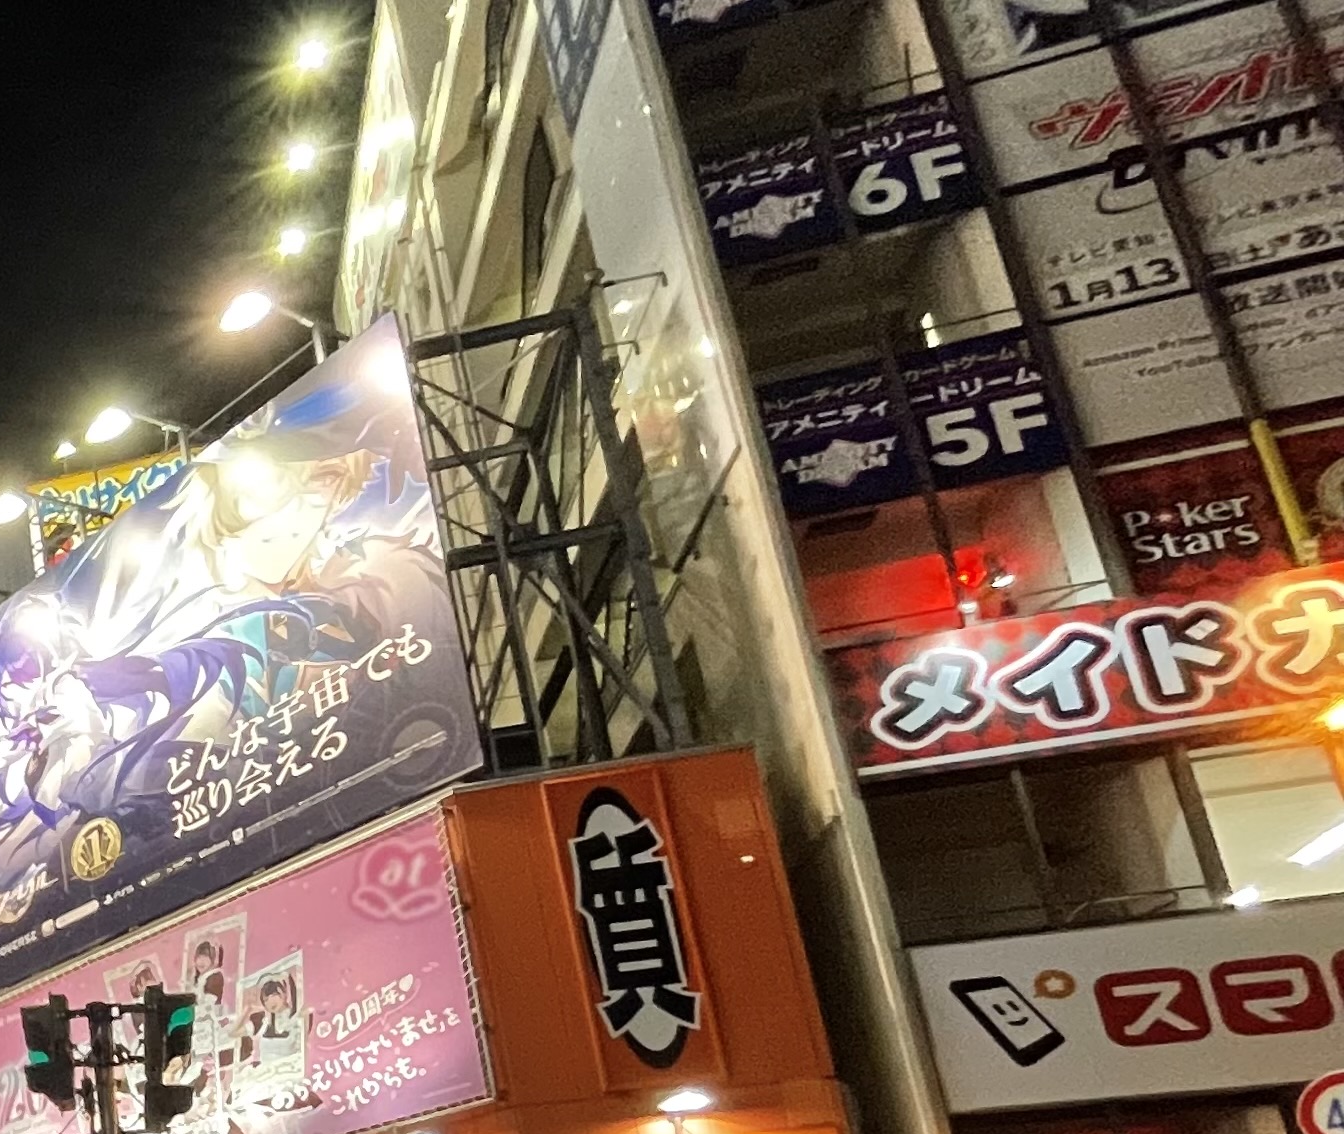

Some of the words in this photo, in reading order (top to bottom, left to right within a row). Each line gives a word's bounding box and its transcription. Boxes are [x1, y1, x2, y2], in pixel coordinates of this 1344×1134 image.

[848, 143, 966, 216] 6F
[926, 391, 1049, 467] 5F
[1130, 518, 1263, 565] Stars
[165, 622, 433, 796] どんな宇宙でも
[170, 716, 351, 842] 巡り会える
[329, 1064, 428, 1117] これからも。
